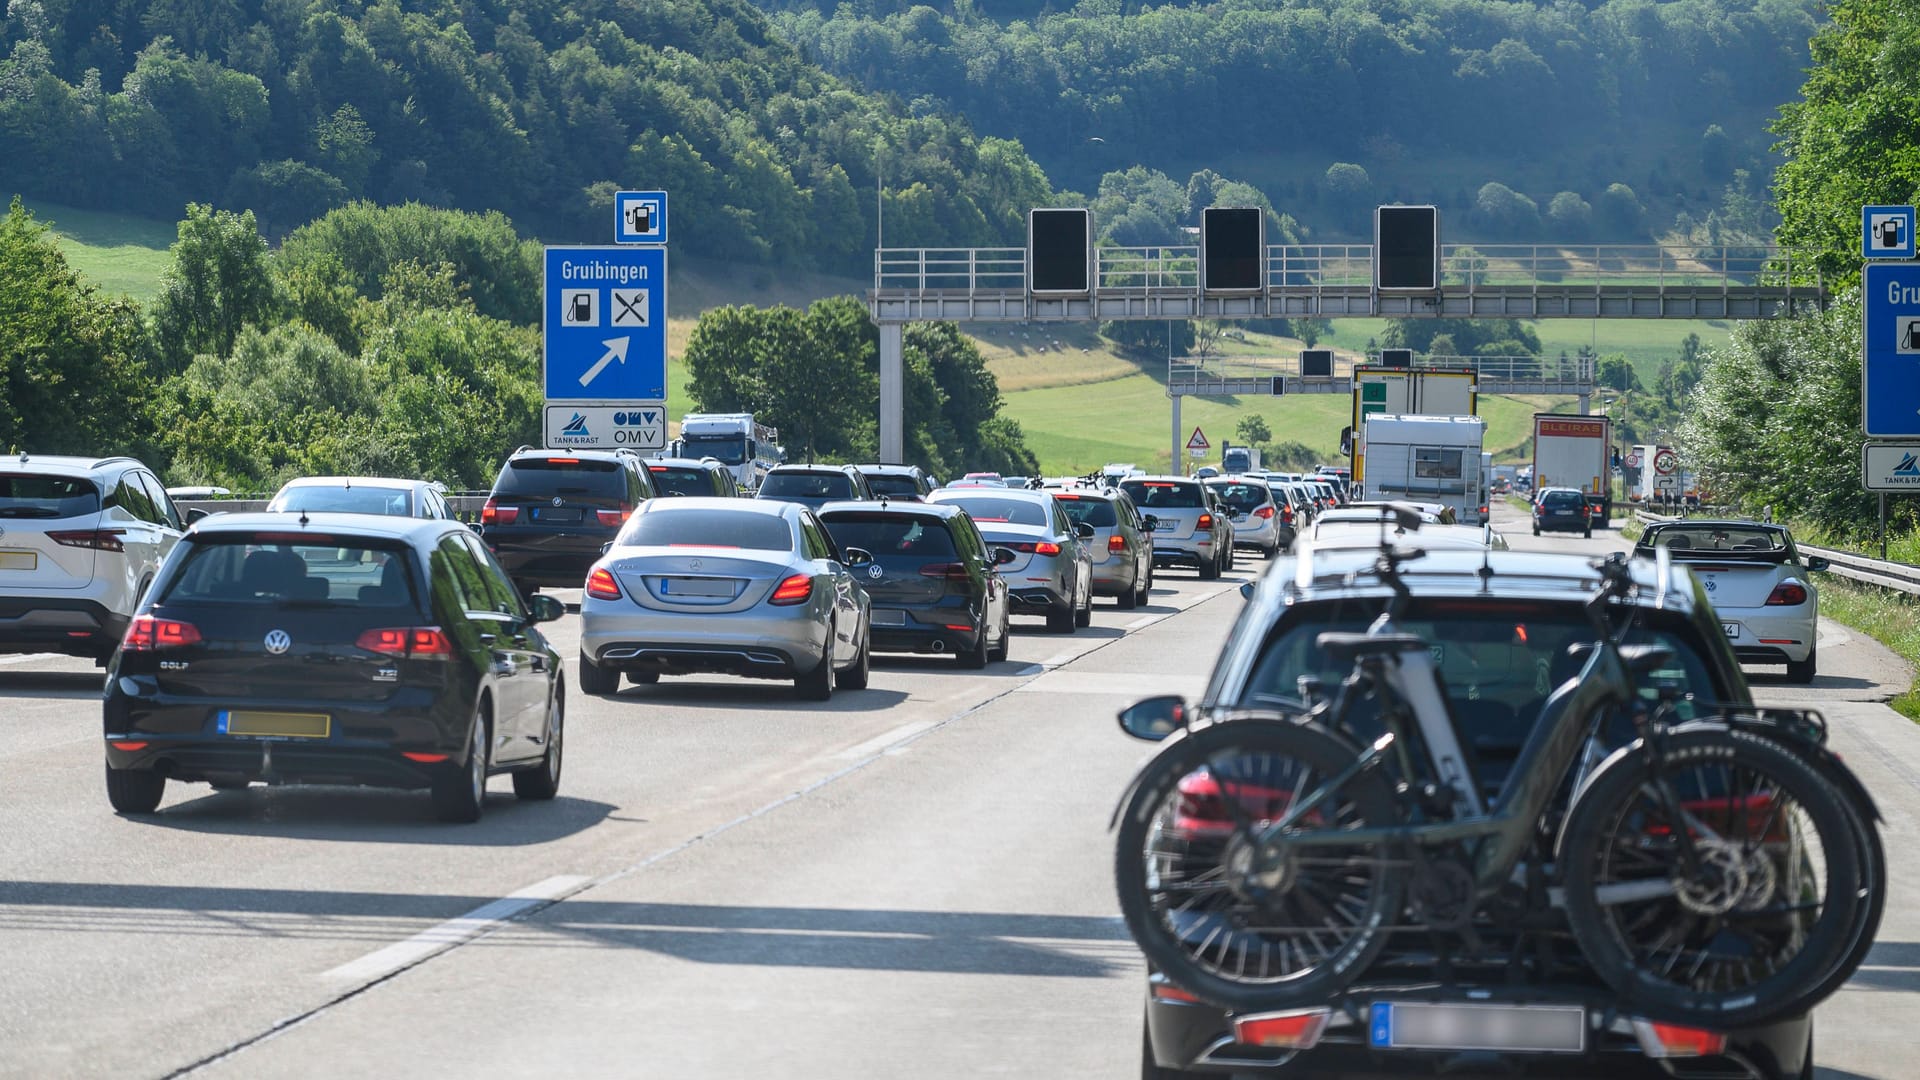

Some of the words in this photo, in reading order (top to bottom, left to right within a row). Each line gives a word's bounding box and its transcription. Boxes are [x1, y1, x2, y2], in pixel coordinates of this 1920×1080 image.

[562, 260, 648, 285] Gruibingen
[1541, 422, 1601, 433] BLEIRAS
[614, 430, 656, 444] OMV
